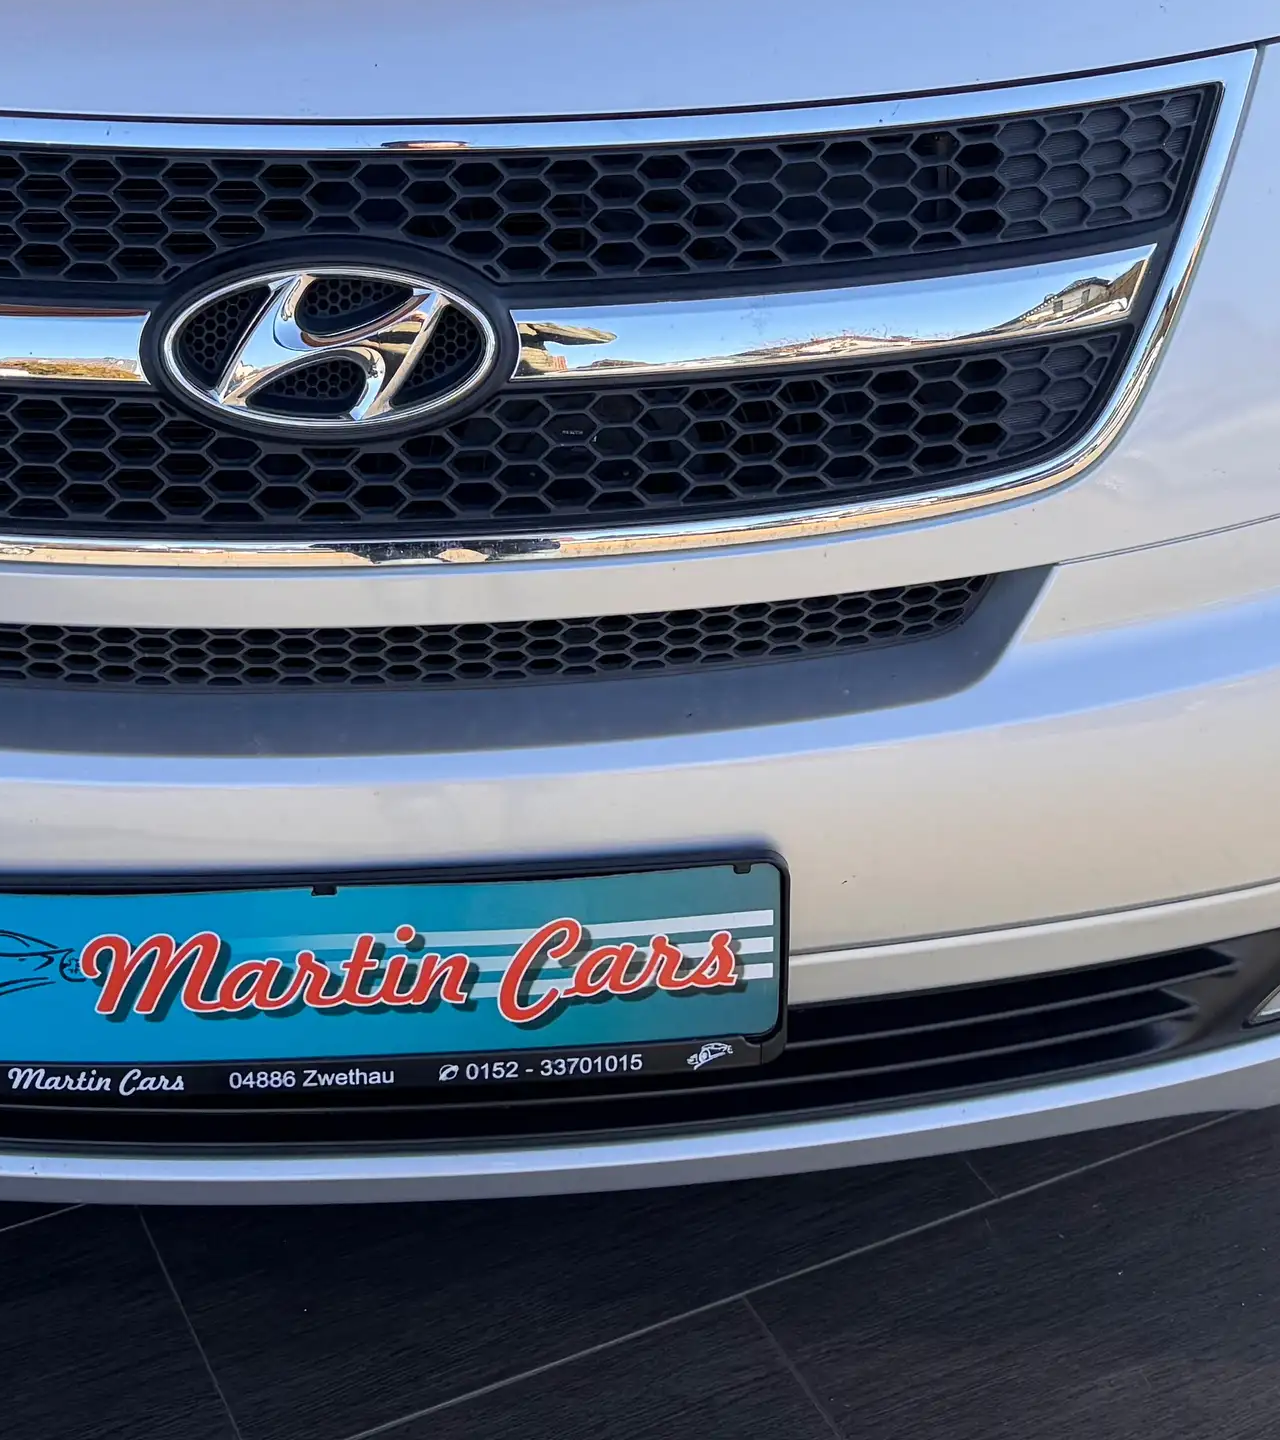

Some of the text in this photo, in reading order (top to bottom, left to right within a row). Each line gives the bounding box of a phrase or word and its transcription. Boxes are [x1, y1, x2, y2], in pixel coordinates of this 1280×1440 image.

[80, 917, 738, 1024] Martin Cars
[7, 1067, 111, 1092] Martin
[118, 1068, 185, 1097] Cars
[228, 1070, 296, 1090] 04886
[302, 1068, 395, 1088] Zwethau
[465, 1060, 519, 1081] 0152
[540, 1053, 643, 1077] 33701015
